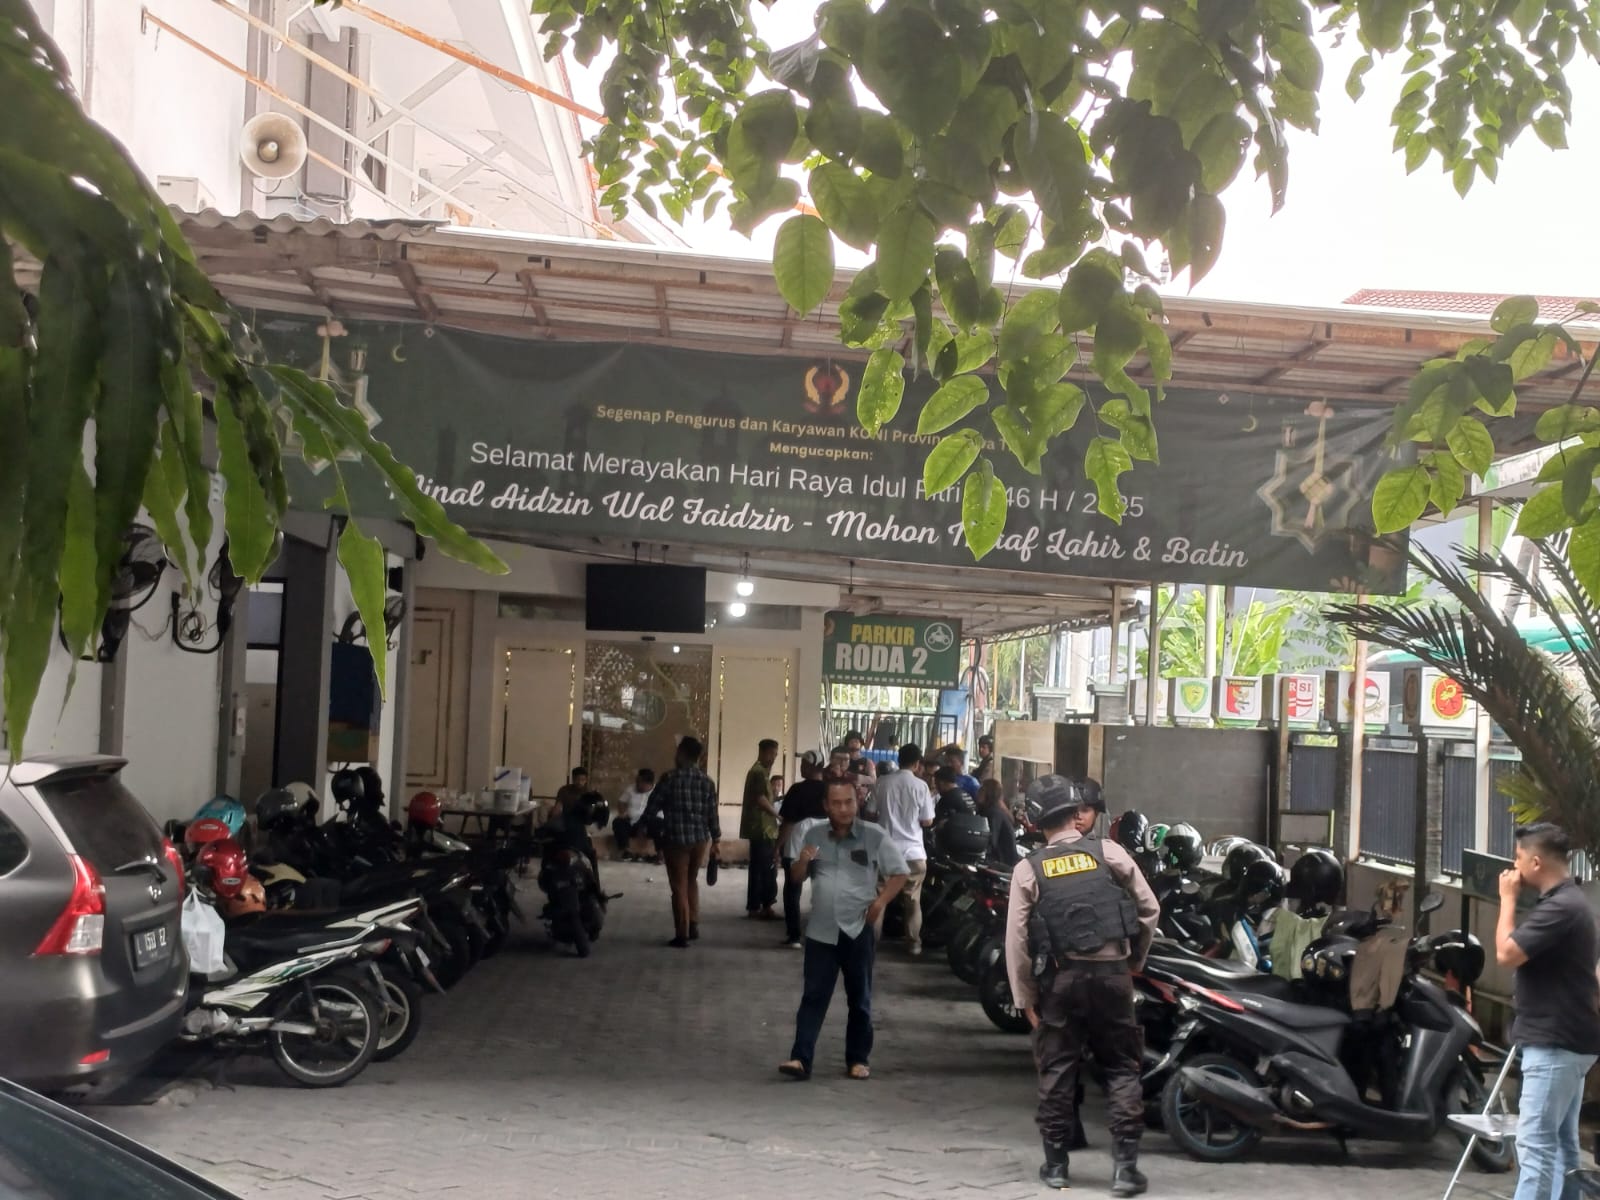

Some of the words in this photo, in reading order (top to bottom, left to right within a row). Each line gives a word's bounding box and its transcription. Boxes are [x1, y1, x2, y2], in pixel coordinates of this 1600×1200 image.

[597, 405, 661, 425] Segenap
[665, 410, 736, 429] Pengurus
[740, 417, 768, 432] dan
[772, 420, 845, 438] Karyawan
[893, 429, 941, 446] Provin
[769, 442, 873, 461] Mengucapkan:
[470, 442, 574, 472] Selamat
[583, 452, 720, 484] Merayakan
[730, 464, 780, 489] Hari
[789, 468, 853, 498] Raya
[863, 475, 906, 498] Idul
[1040, 489, 1057, 512] H
[1066, 491, 1075, 513] /
[490, 483, 593, 516] Aidzin
[602, 490, 675, 522] Wal
[682, 498, 794, 533] Faidzin
[826, 509, 940, 545] Mohon
[1046, 527, 1127, 561] Lahir
[1133, 535, 1152, 561] &
[1161, 536, 1249, 568] Batin
[851, 624, 916, 646] PARKIR
[835, 642, 906, 675] RODA
[911, 647, 928, 675] 2
[1288, 682, 1312, 692] RSI
[1045, 854, 1094, 875] POLISI
